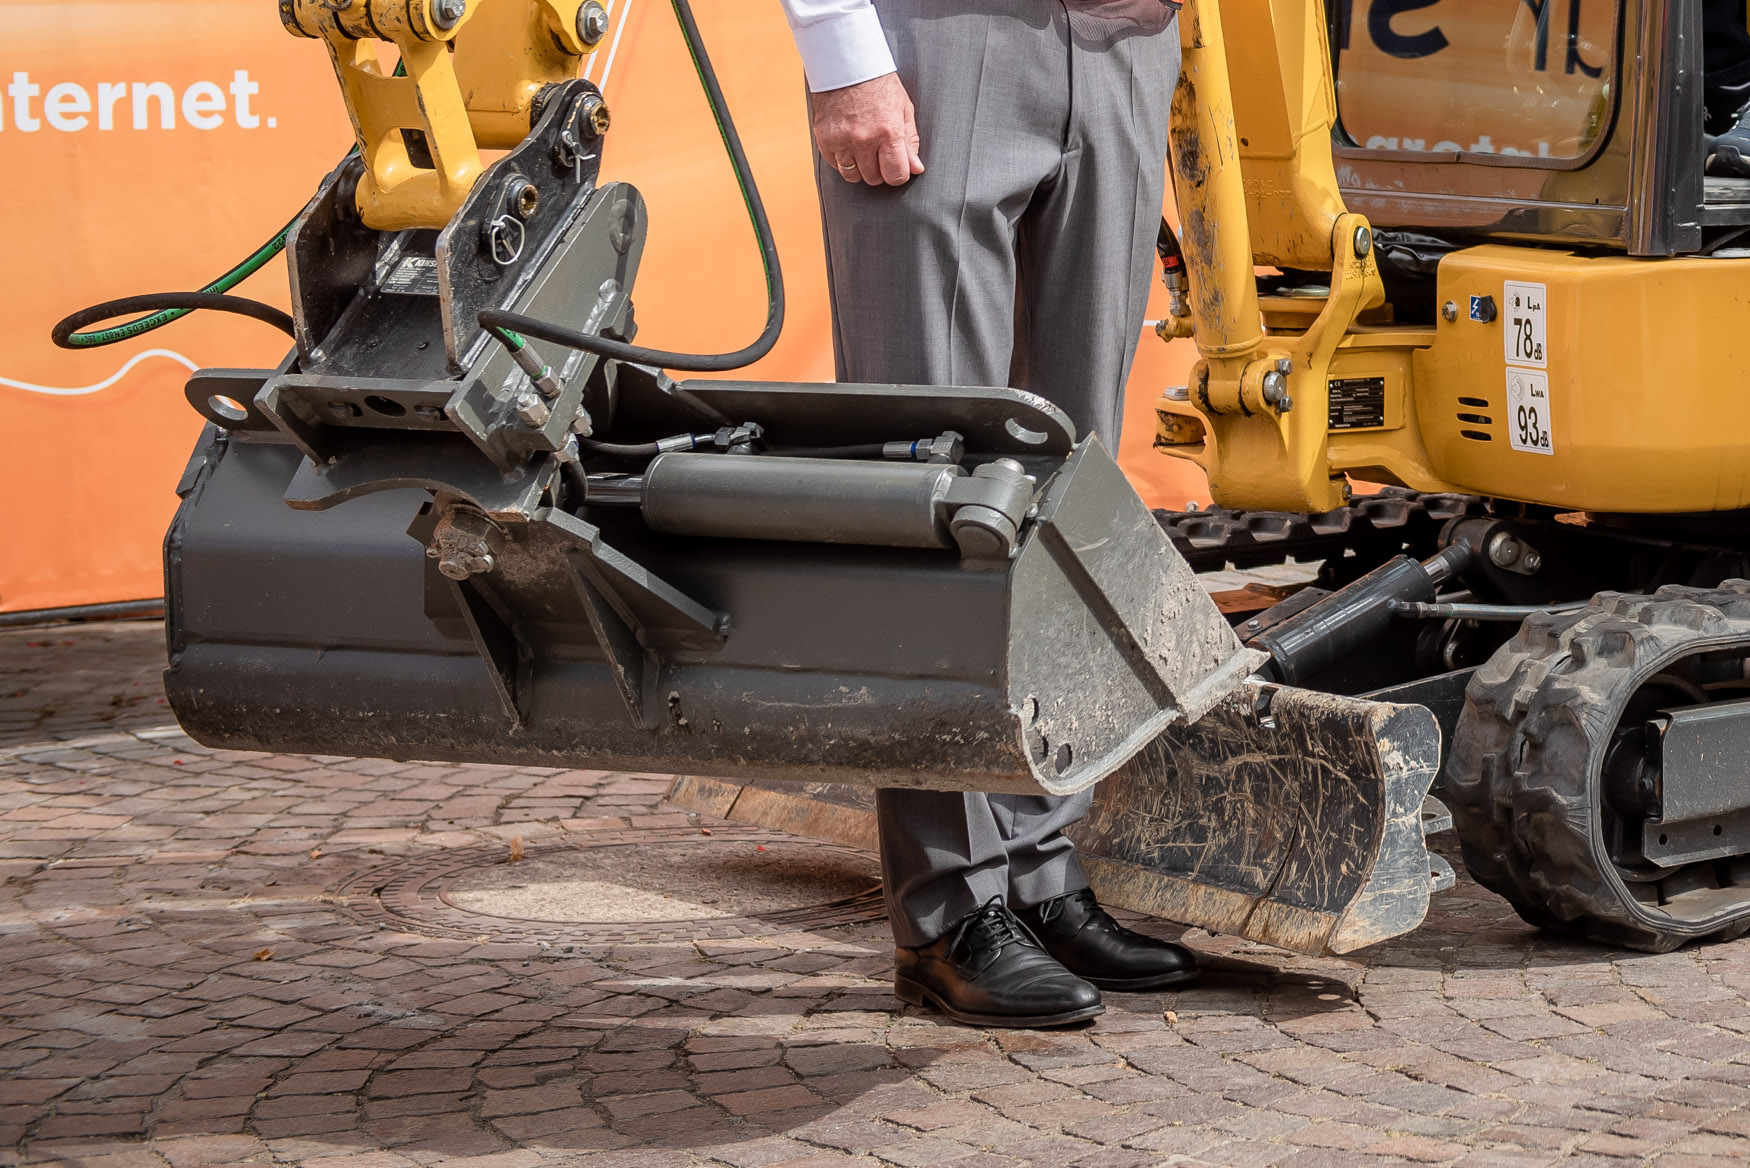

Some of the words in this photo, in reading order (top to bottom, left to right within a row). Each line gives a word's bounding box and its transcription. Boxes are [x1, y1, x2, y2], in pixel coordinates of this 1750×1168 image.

[0, 69, 277, 132] ternet.
[126, 313, 168, 334] EXCEEDS
[1513, 318, 1533, 359] 78
[1533, 343, 1543, 361] dB
[1517, 405, 1540, 447] 93
[1540, 430, 1549, 448] dB
